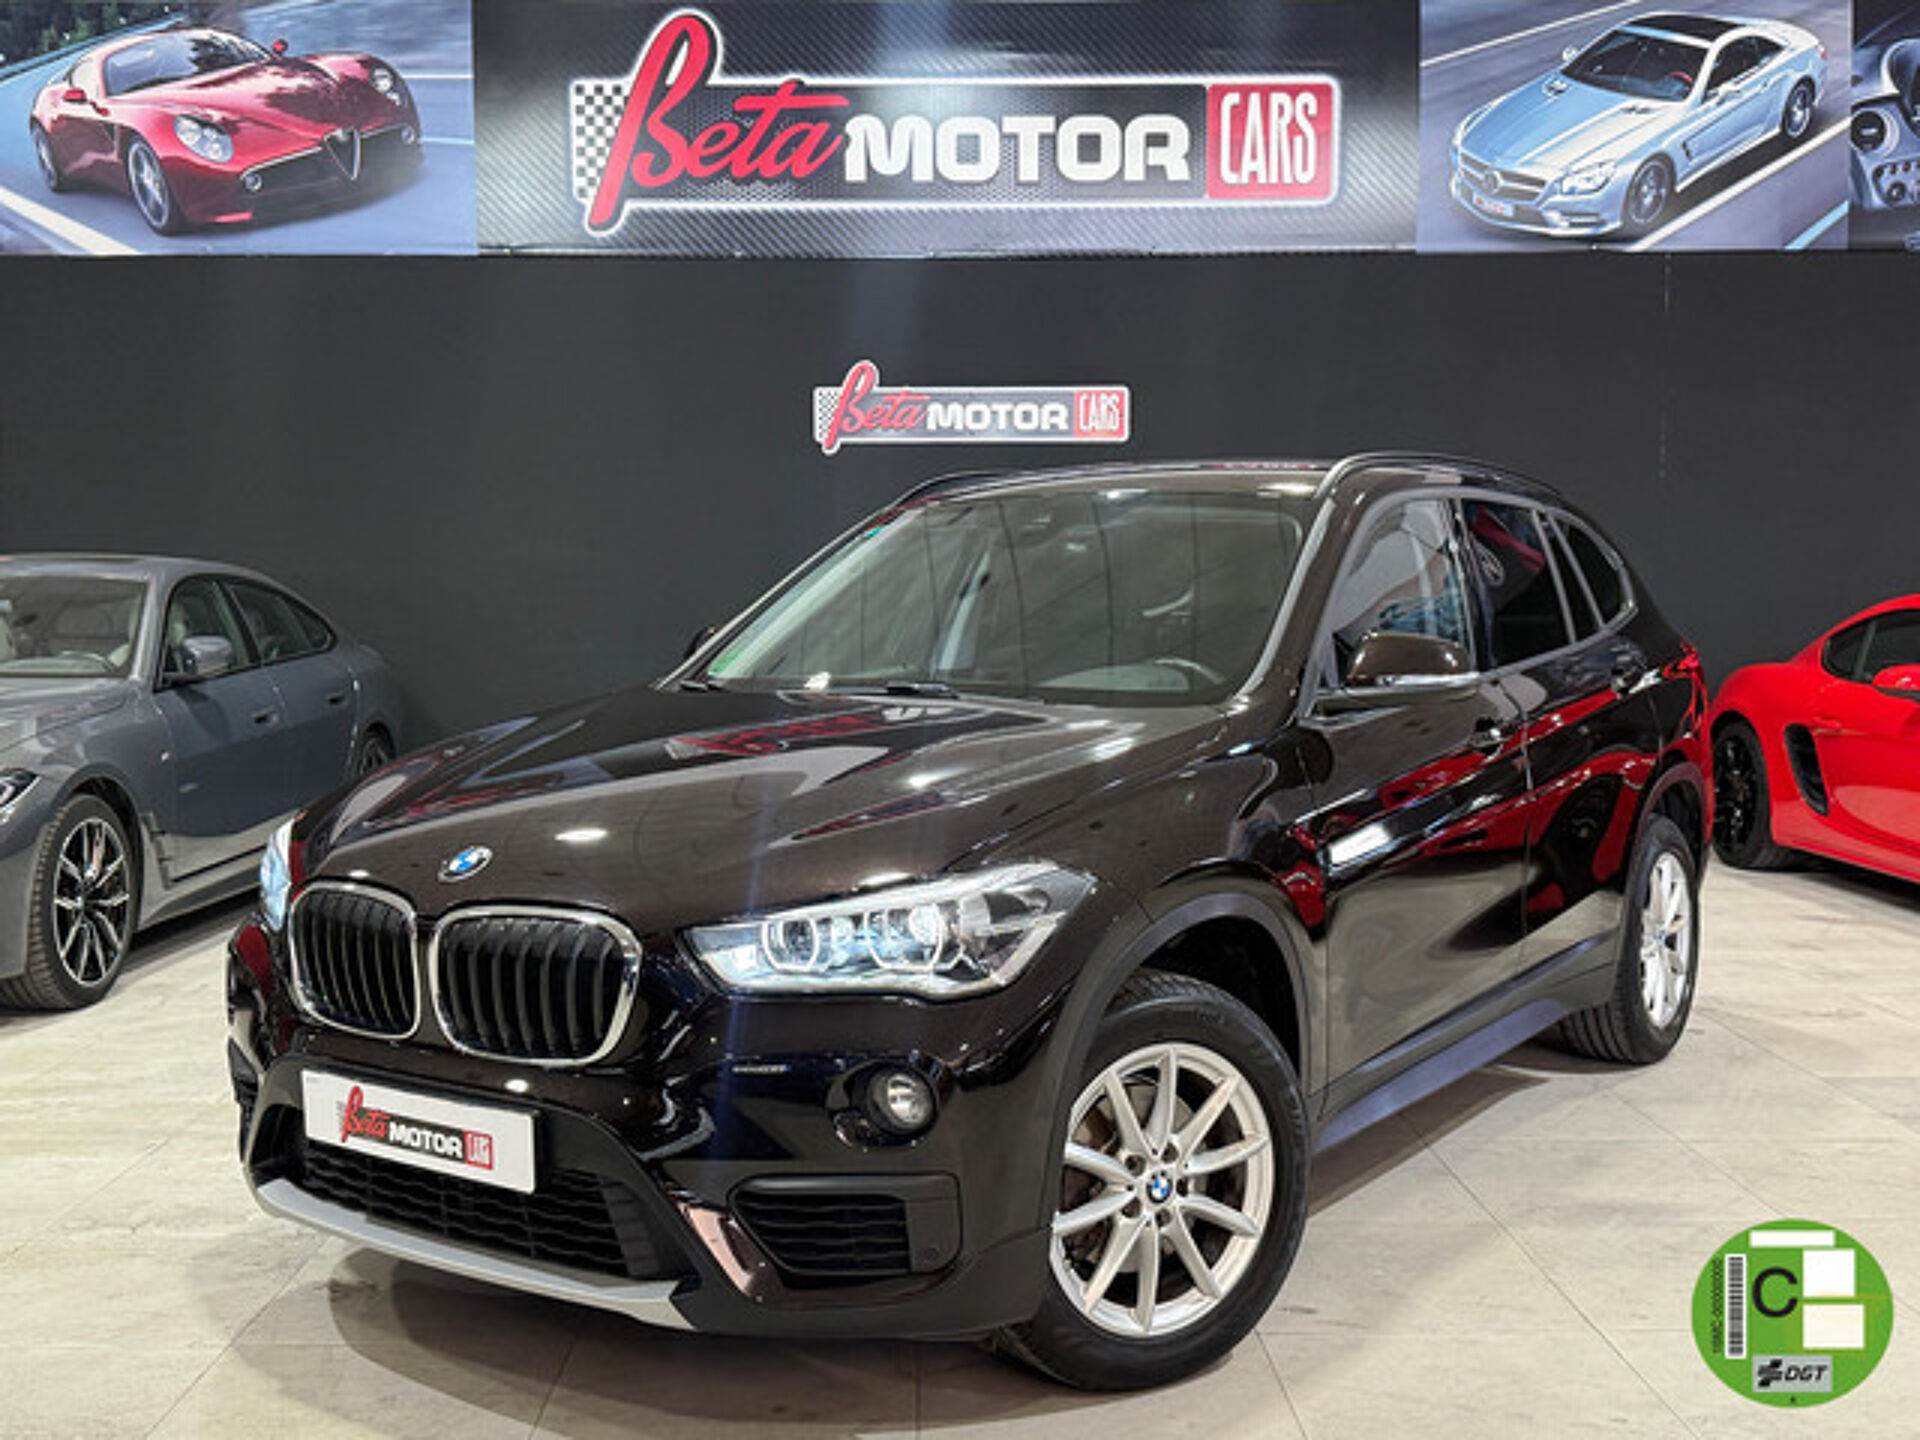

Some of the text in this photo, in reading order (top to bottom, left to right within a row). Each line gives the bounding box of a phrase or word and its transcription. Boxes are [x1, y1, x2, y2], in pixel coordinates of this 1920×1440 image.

[588, 12, 1320, 226] Beta MOTOR CARS
[925, 401, 1069, 431] MOTOR
[1078, 391, 1120, 433] CARS
[388, 1120, 463, 1159] MOTOR
